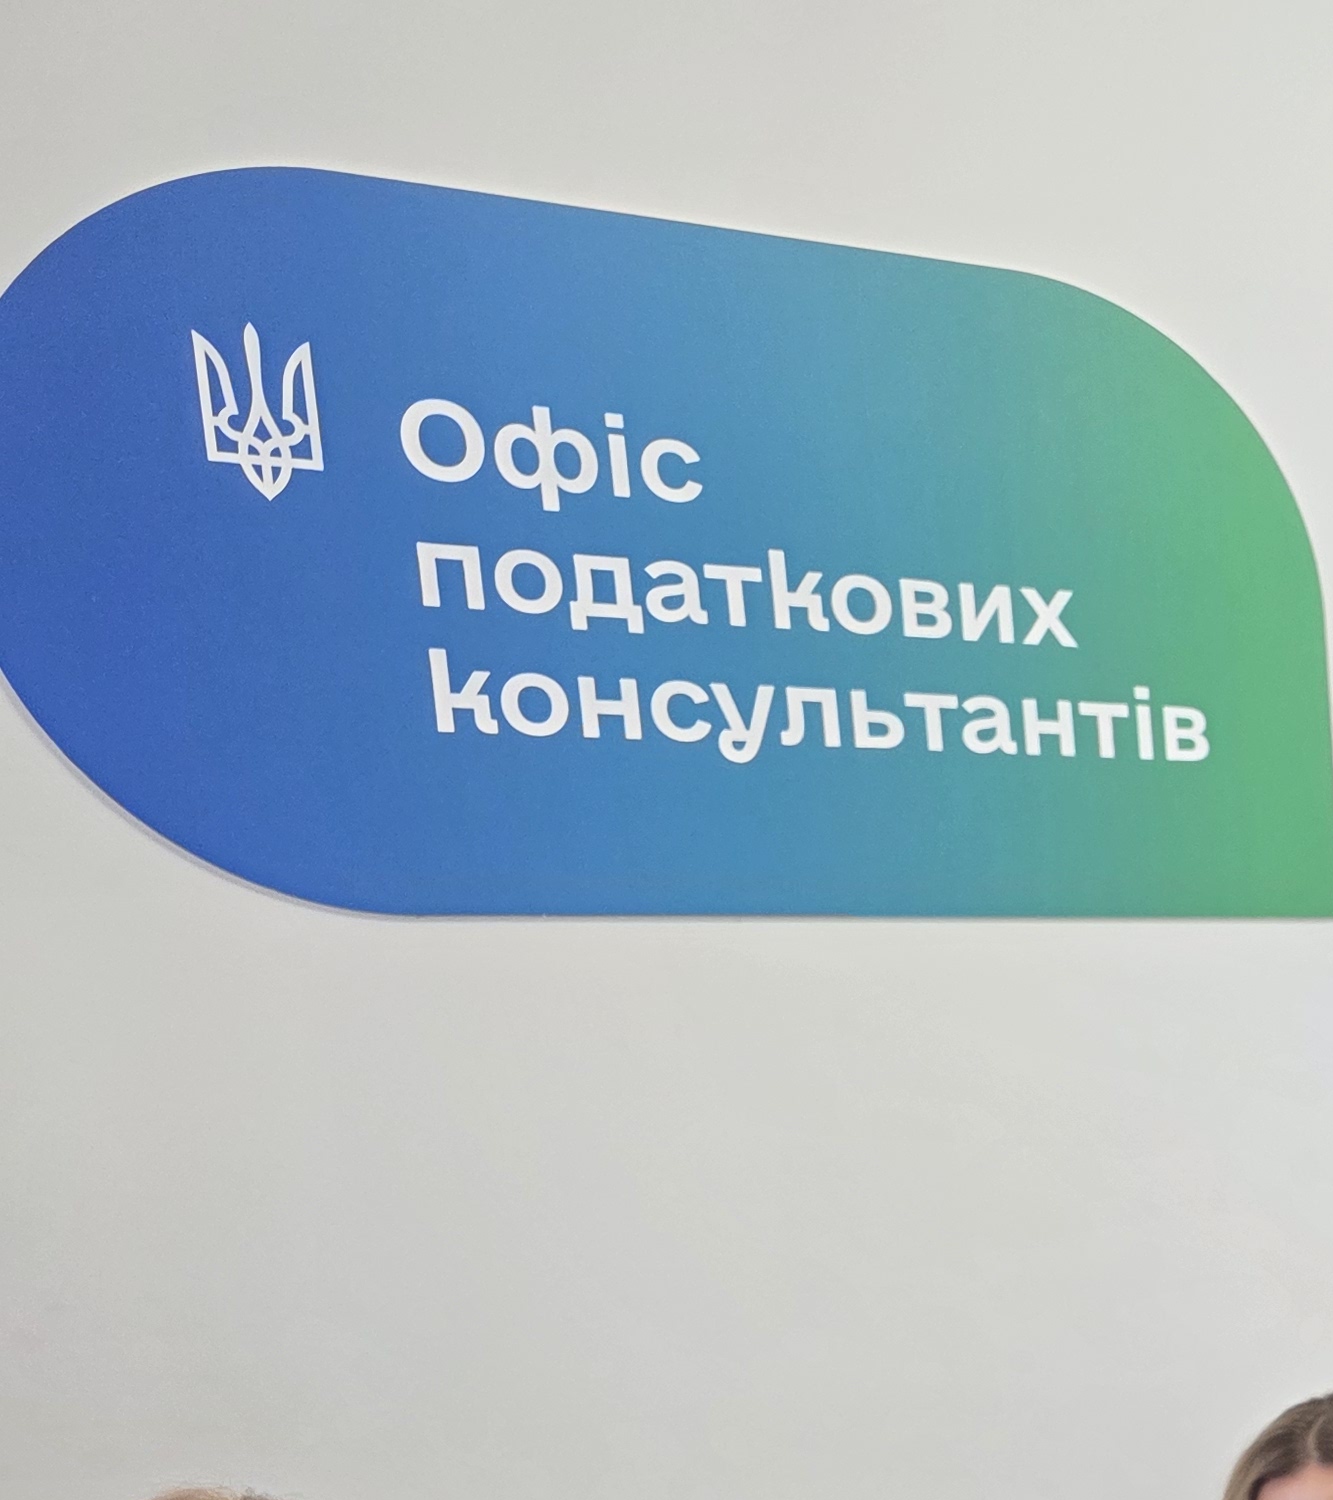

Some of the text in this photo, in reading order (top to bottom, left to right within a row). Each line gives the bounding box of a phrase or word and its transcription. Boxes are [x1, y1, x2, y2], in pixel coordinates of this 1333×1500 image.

[399, 396, 703, 512] Офіс
[415, 540, 1079, 649] податкових
[428, 649, 1211, 763] консультантів
